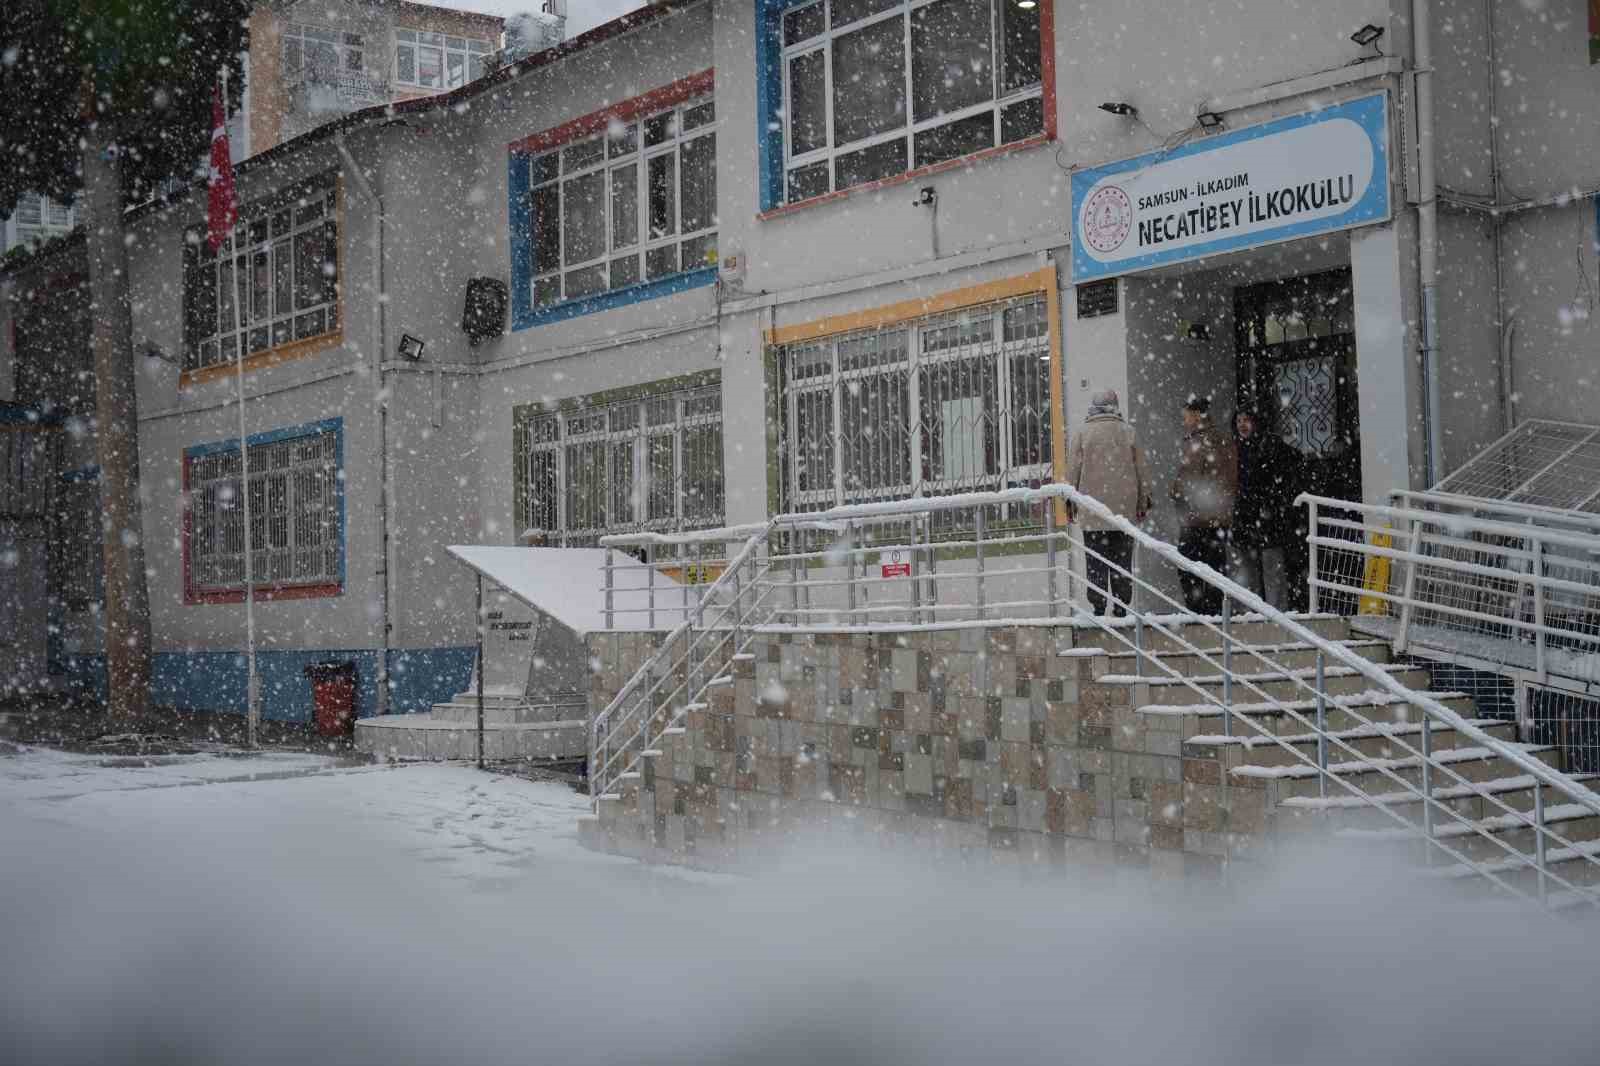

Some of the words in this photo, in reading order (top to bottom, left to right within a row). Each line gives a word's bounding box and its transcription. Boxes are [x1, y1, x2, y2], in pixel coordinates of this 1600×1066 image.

[1138, 187, 1188, 210] SAMSUN
[1197, 172, 1249, 197] İLKADIM
[1138, 199, 1244, 247] NECATİBEY
